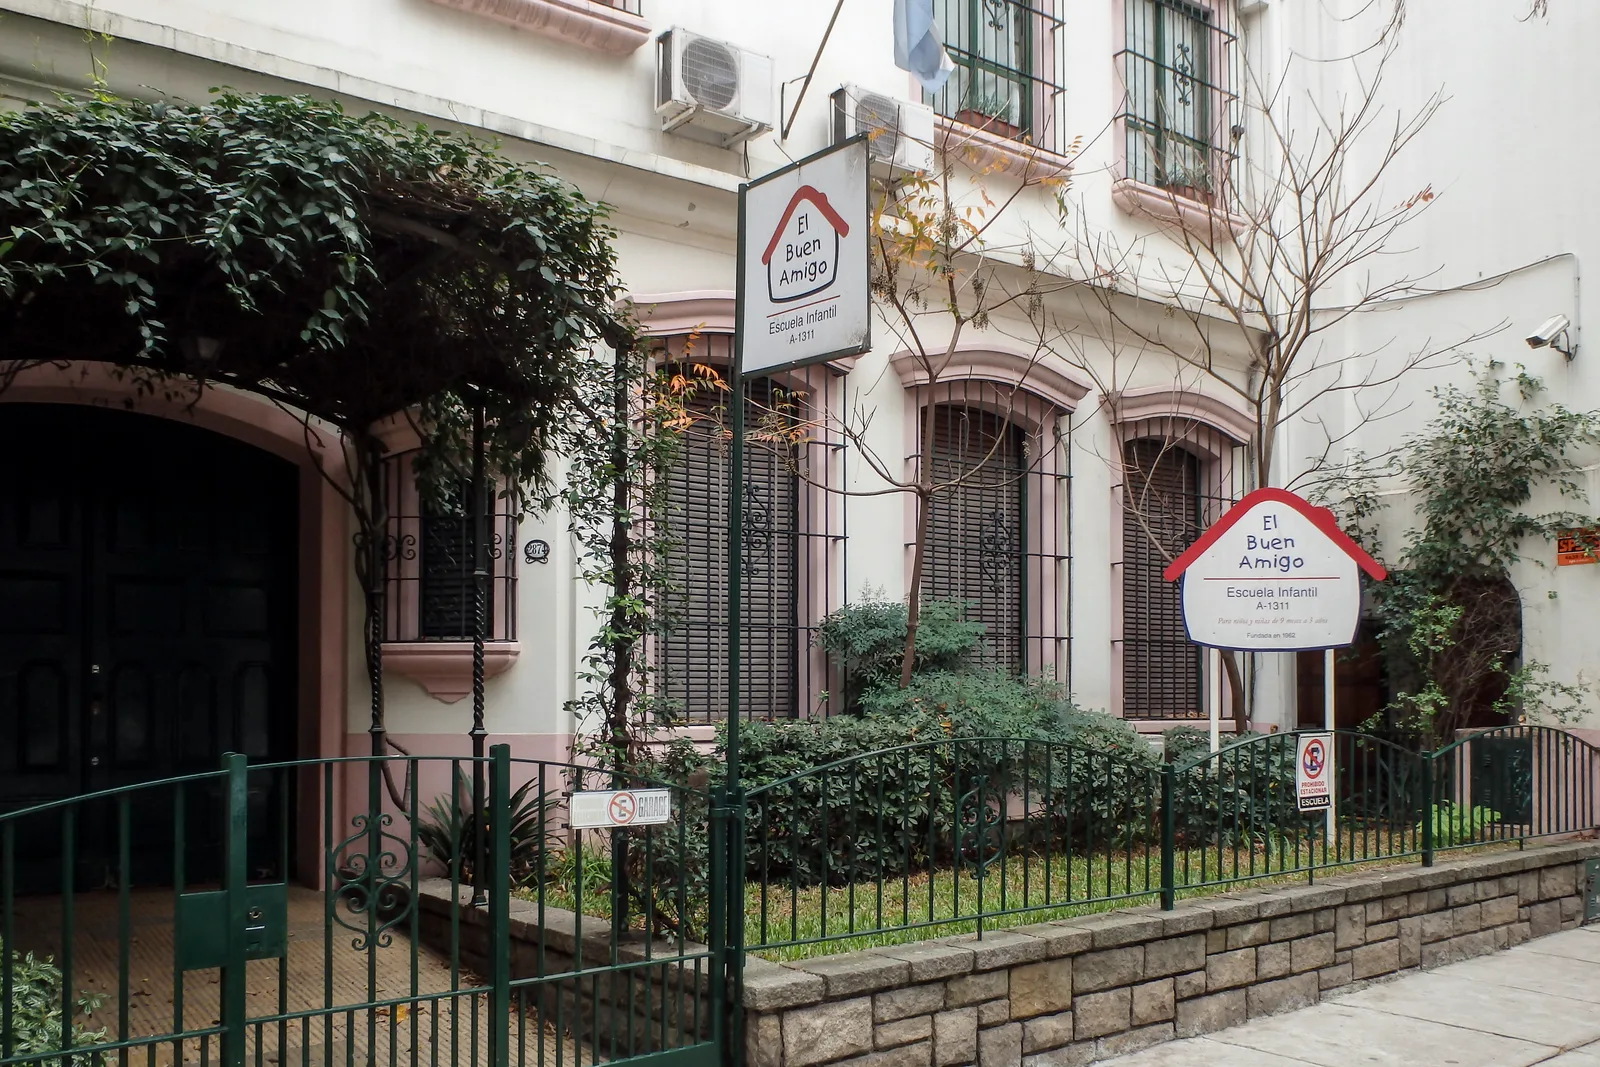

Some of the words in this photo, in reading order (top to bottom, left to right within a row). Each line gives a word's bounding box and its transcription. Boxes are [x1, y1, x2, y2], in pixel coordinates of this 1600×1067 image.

[798, 213, 809, 235] El
[786, 238, 821, 262] Buen
[779, 260, 828, 286] Amigo
[769, 317, 803, 335] Escuela
[806, 304, 837, 325] Infantil
[789, 329, 815, 345] A-1311
[1263, 514, 1278, 531] El
[526, 543, 546, 554] 2874
[1246, 535, 1295, 550] Buen
[1239, 554, 1304, 572] Amigo
[1227, 587, 1274, 598] Escuela
[1278, 587, 1318, 598] Infantil
[1256, 601, 1290, 611] A-1311
[1217, 617, 1232, 625] Para
[1300, 787, 1327, 795] ESTACIONAR
[638, 796, 667, 817] GARAGE
[1301, 798, 1329, 806] ESCUELA
